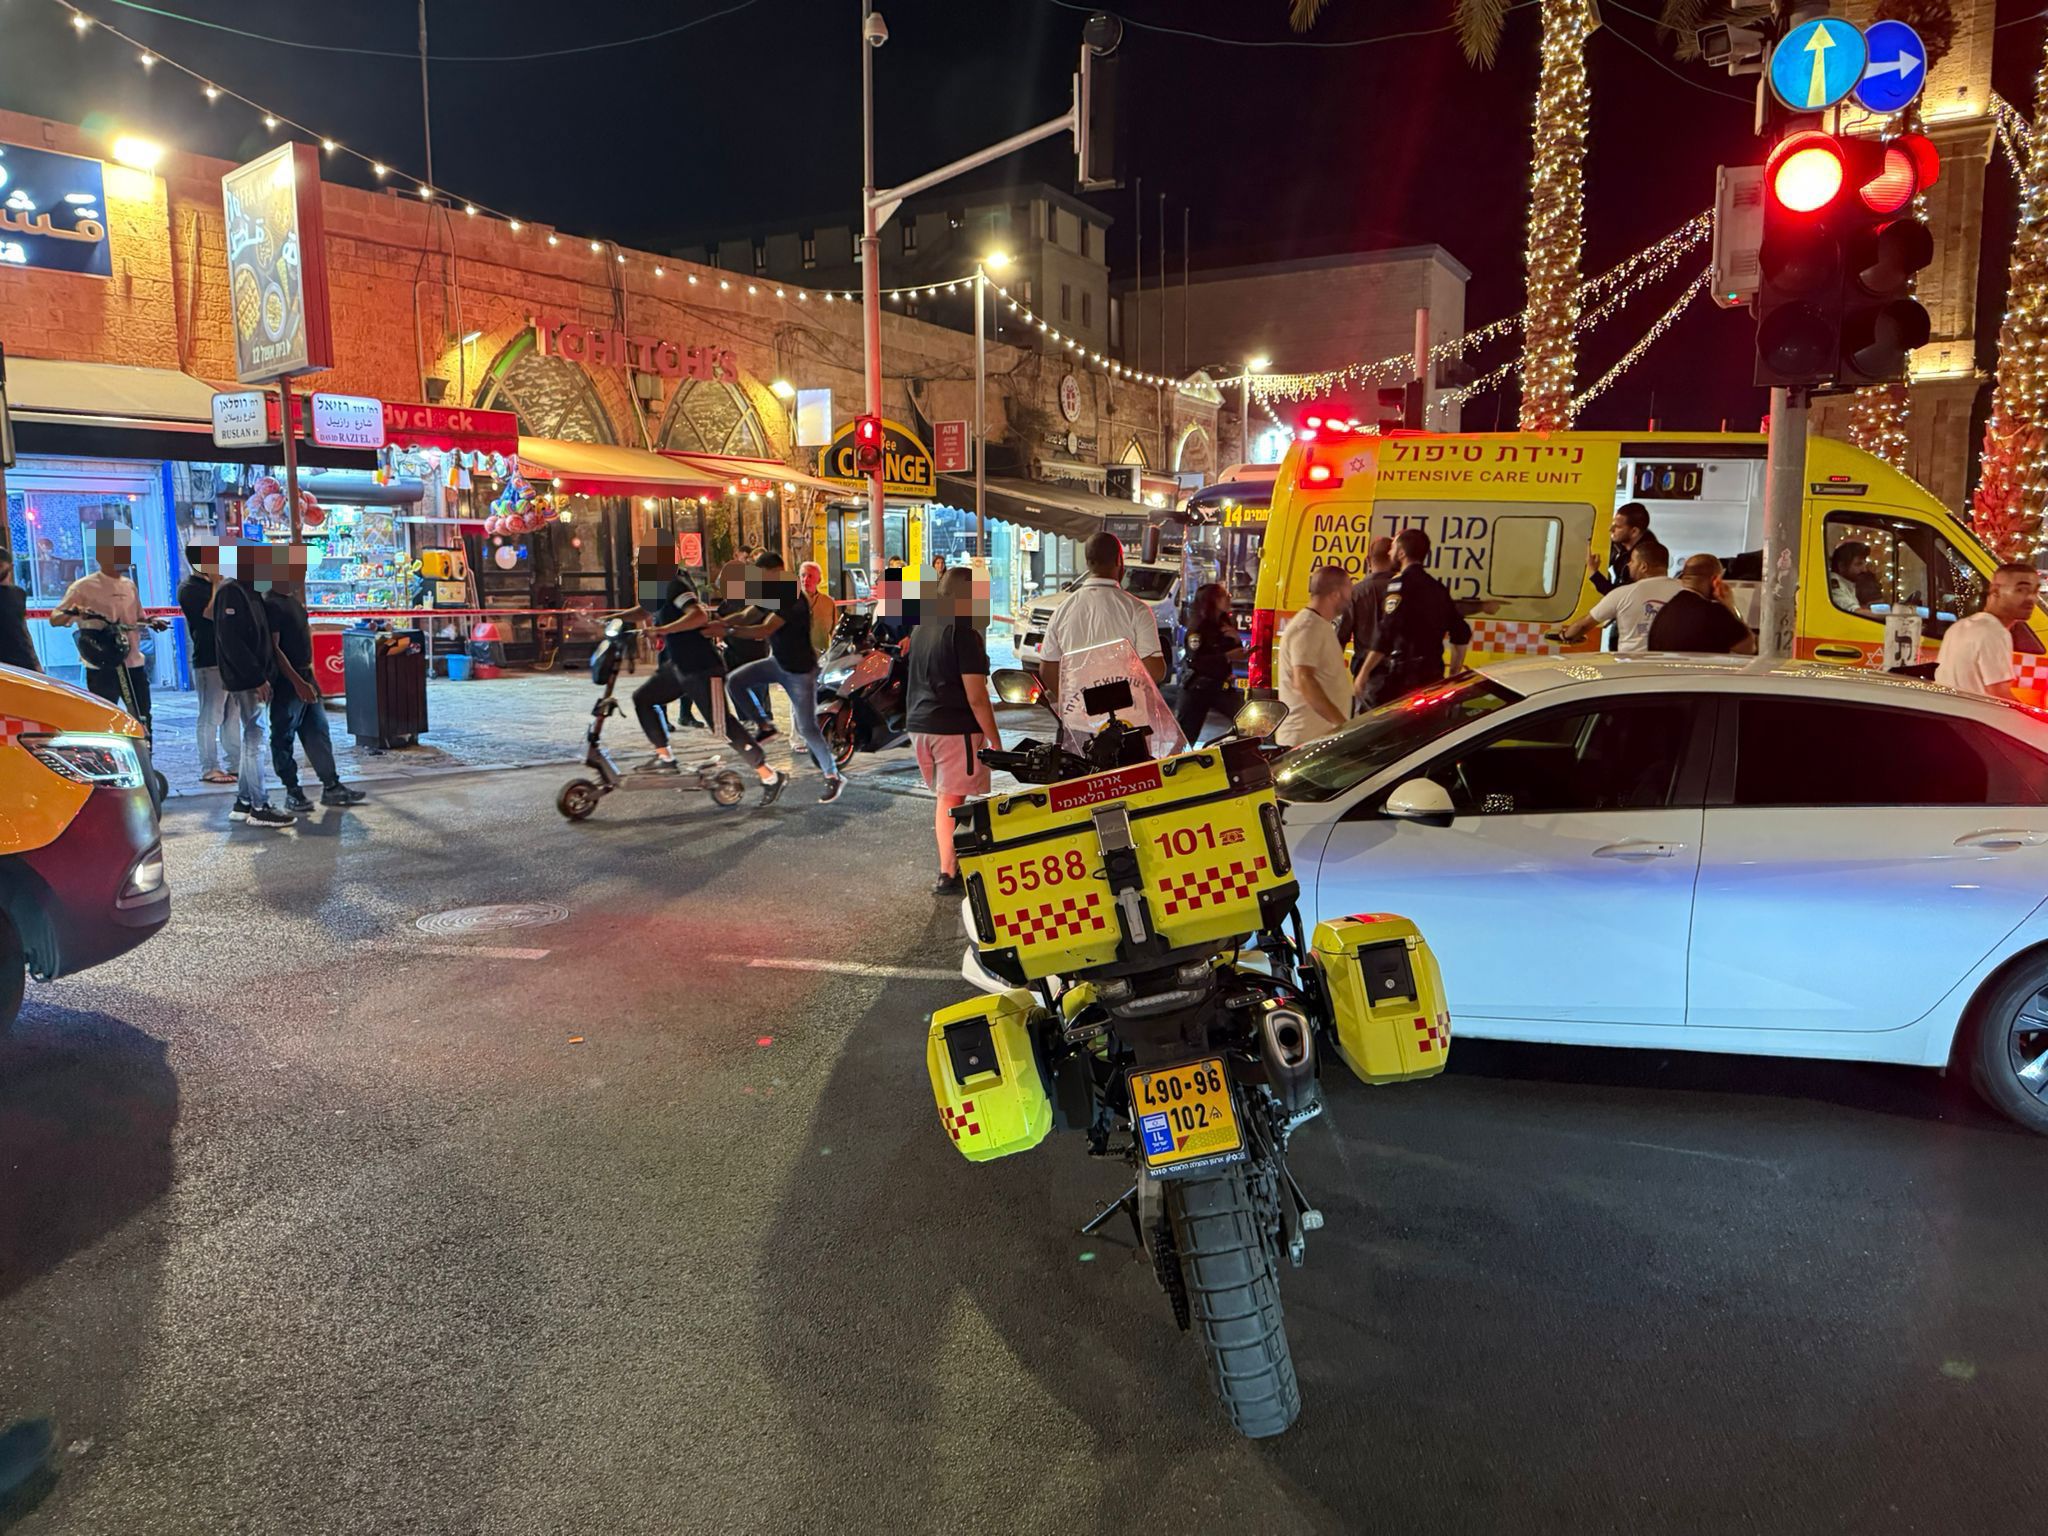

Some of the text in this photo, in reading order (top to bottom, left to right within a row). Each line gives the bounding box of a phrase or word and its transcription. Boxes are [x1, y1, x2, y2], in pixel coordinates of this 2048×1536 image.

[219, 397, 248, 413] רוסלאן
[317, 397, 350, 412] רזיאל
[413, 407, 474, 431] clck
[942, 424, 958, 434] ATM
[221, 428, 251, 440] RUSLAN
[320, 433, 338, 441] DAVID
[1392, 442, 1584, 465] ניידת טיפול
[838, 447, 927, 484] CNGE
[1377, 469, 1583, 485] INTENSIVE CARE UNIT
[1224, 504, 1243, 527] 14
[1314, 514, 1372, 533] MAG
[1441, 516, 1488, 543] מגן
[1310, 555, 1368, 574] ADO
[1058, 779, 1156, 808] ההצלה הלאומי
[1087, 775, 1121, 791] ארגון
[1154, 822, 1217, 859] 101
[997, 850, 1086, 896] 5588
[1145, 1068, 1221, 1106] 490-96
[1170, 1103, 1209, 1132] 102
[1153, 1131, 1164, 1141] IL
